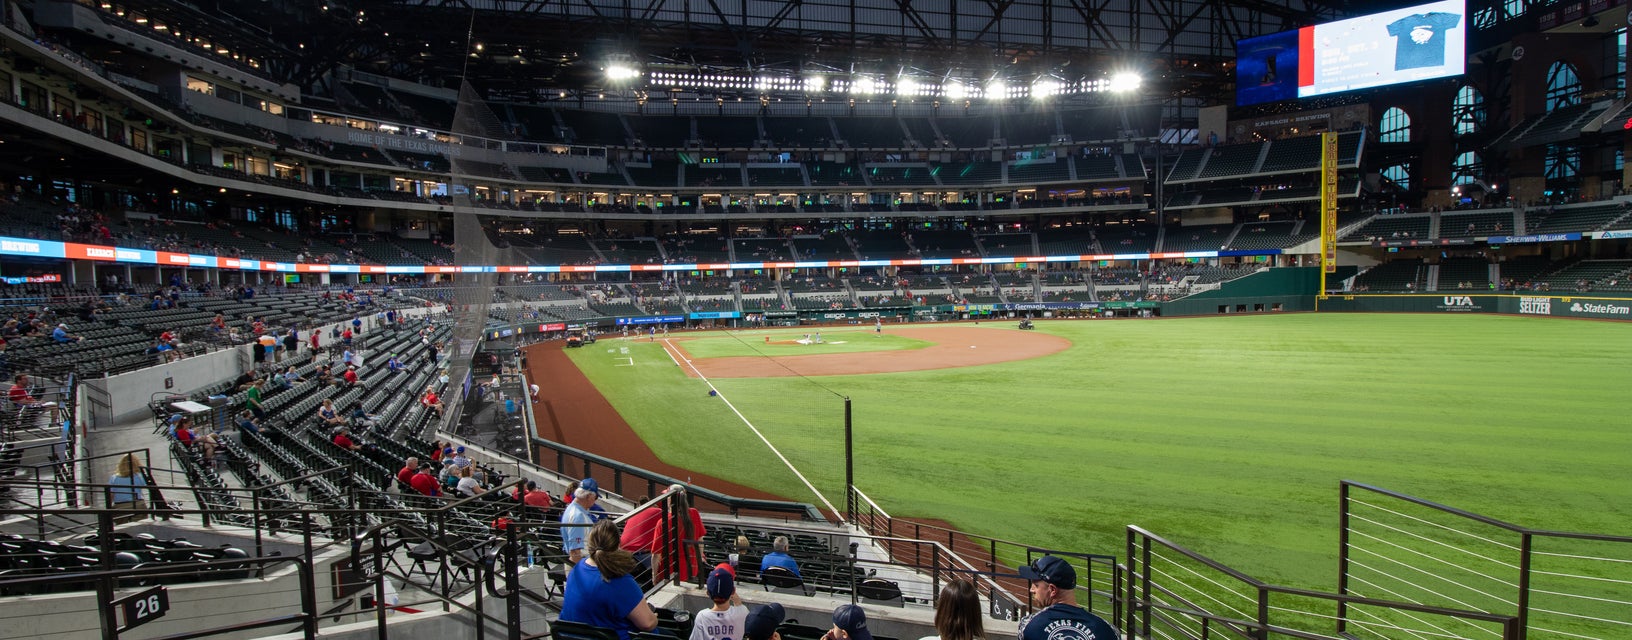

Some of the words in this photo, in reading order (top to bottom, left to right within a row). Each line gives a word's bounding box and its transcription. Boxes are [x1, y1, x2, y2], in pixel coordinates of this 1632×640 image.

[348, 132, 373, 144] HOME
[375, 136, 385, 145] OF
[388, 138, 402, 148] THE
[404, 140, 427, 151] TEXAS
[429, 144, 461, 156] RANGERS
[1444, 296, 1473, 306] UTA
[1519, 301, 1551, 315] SELTZER
[135, 594, 160, 619] 26
[707, 625, 734, 635] ODOR
[1044, 619, 1072, 633] TEXAS
[1075, 622, 1096, 640] FIRE
